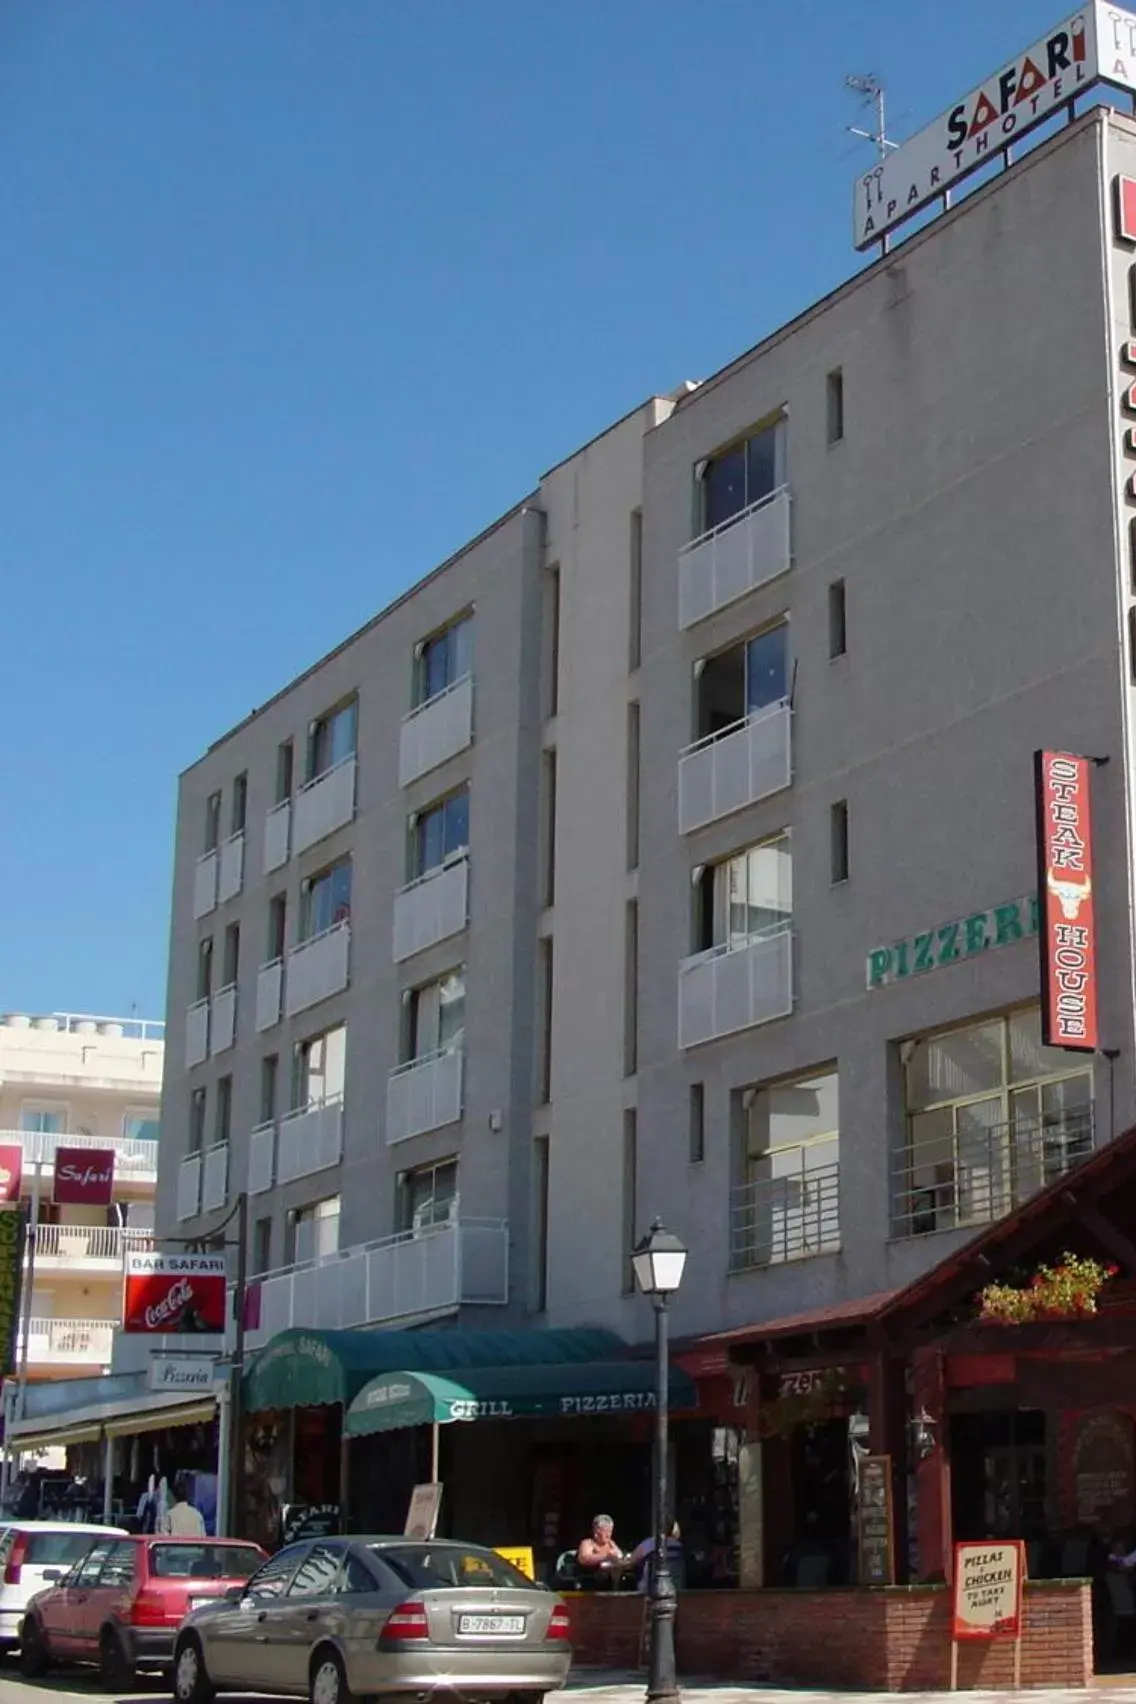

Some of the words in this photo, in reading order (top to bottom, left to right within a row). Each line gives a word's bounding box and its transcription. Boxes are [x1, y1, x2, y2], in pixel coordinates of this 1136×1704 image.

[947, 16, 1086, 151] SAFARI
[1050, 759, 1084, 870] STEAK
[867, 896, 1038, 990] PIZZERI
[1055, 924, 1087, 1038] HOUSE
[57, 1164, 112, 1187] Safari
[131, 1257, 165, 1271] BAR
[168, 1257, 225, 1271] SAFARI
[450, 1400, 513, 1418] GRILL
[561, 1392, 658, 1413] PIZZERIA
[965, 1568, 1013, 1588] CHICKEN
